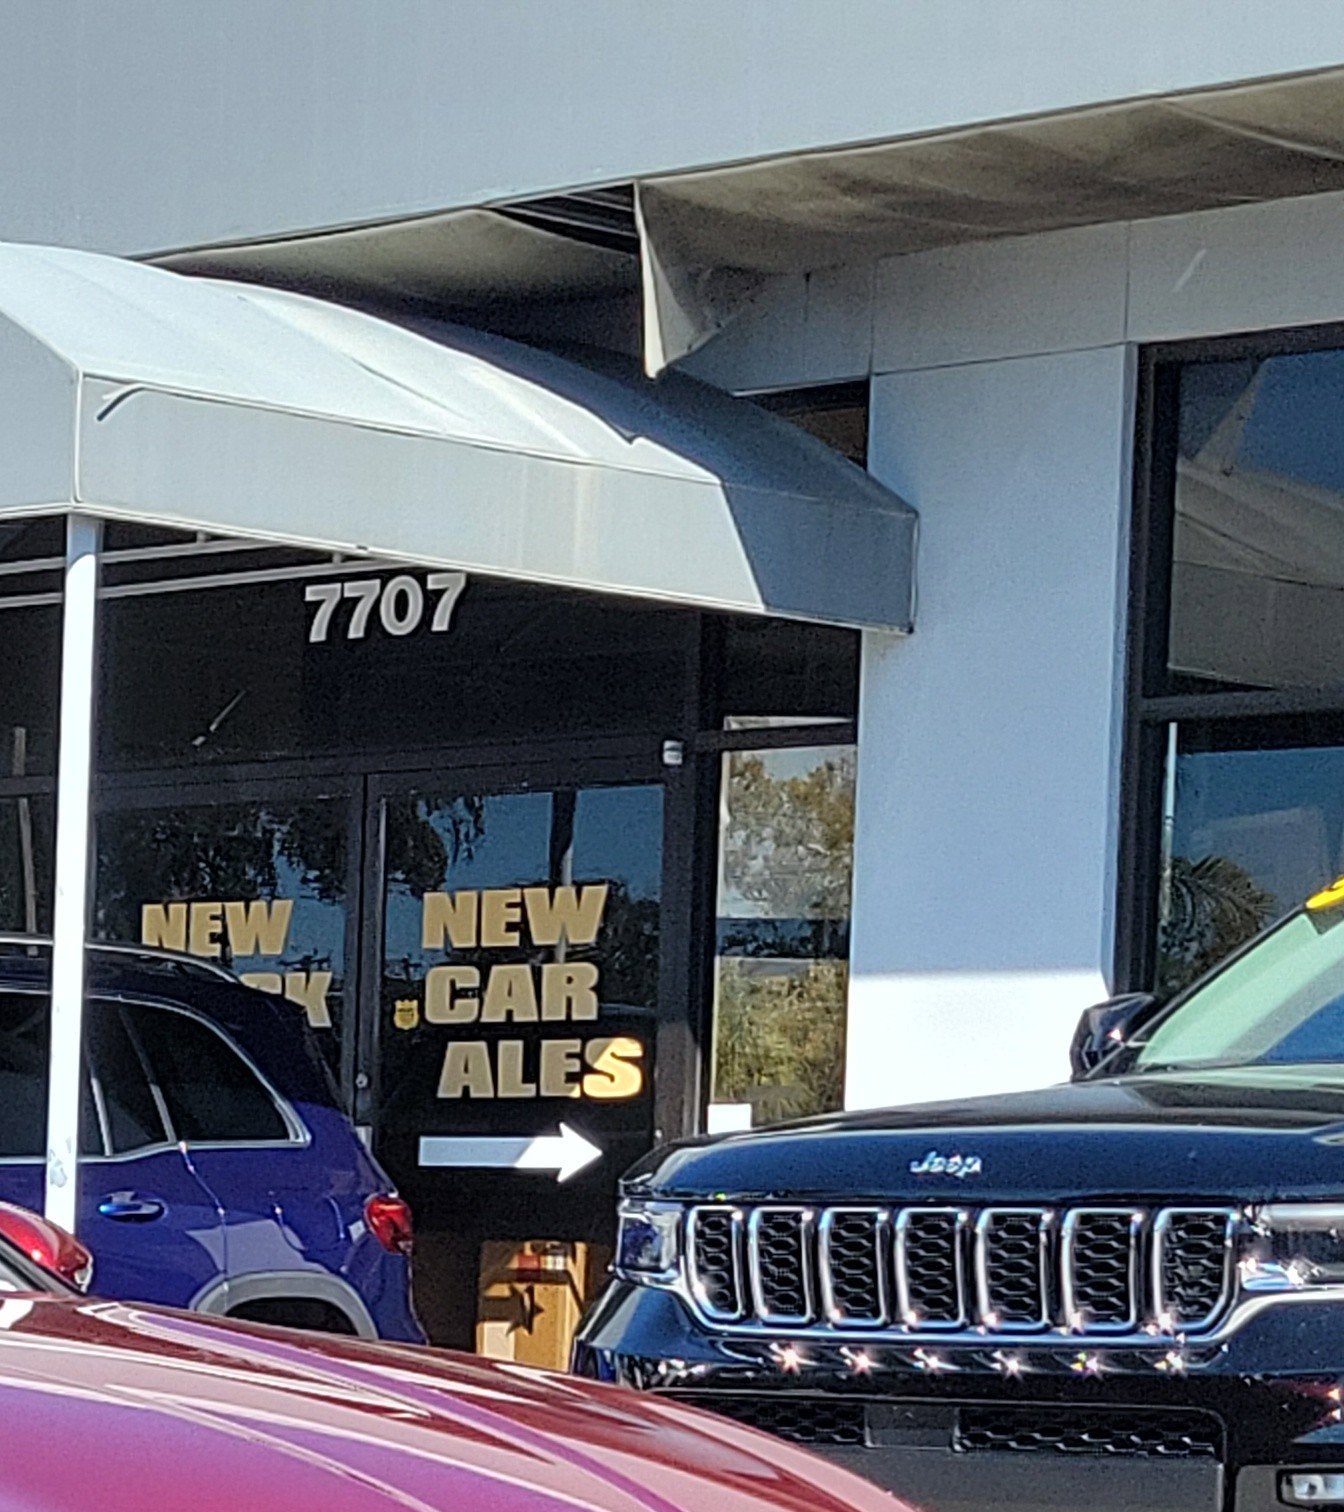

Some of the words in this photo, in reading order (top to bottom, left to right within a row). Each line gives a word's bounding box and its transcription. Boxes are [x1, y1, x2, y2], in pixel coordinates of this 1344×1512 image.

[305, 572, 466, 643] 7707
[142, 899, 294, 957] NEW
[422, 884, 608, 949] NEW
[425, 961, 599, 1024] CAR
[436, 1037, 643, 1098] ALES
[910, 1150, 982, 1179] Jeep
